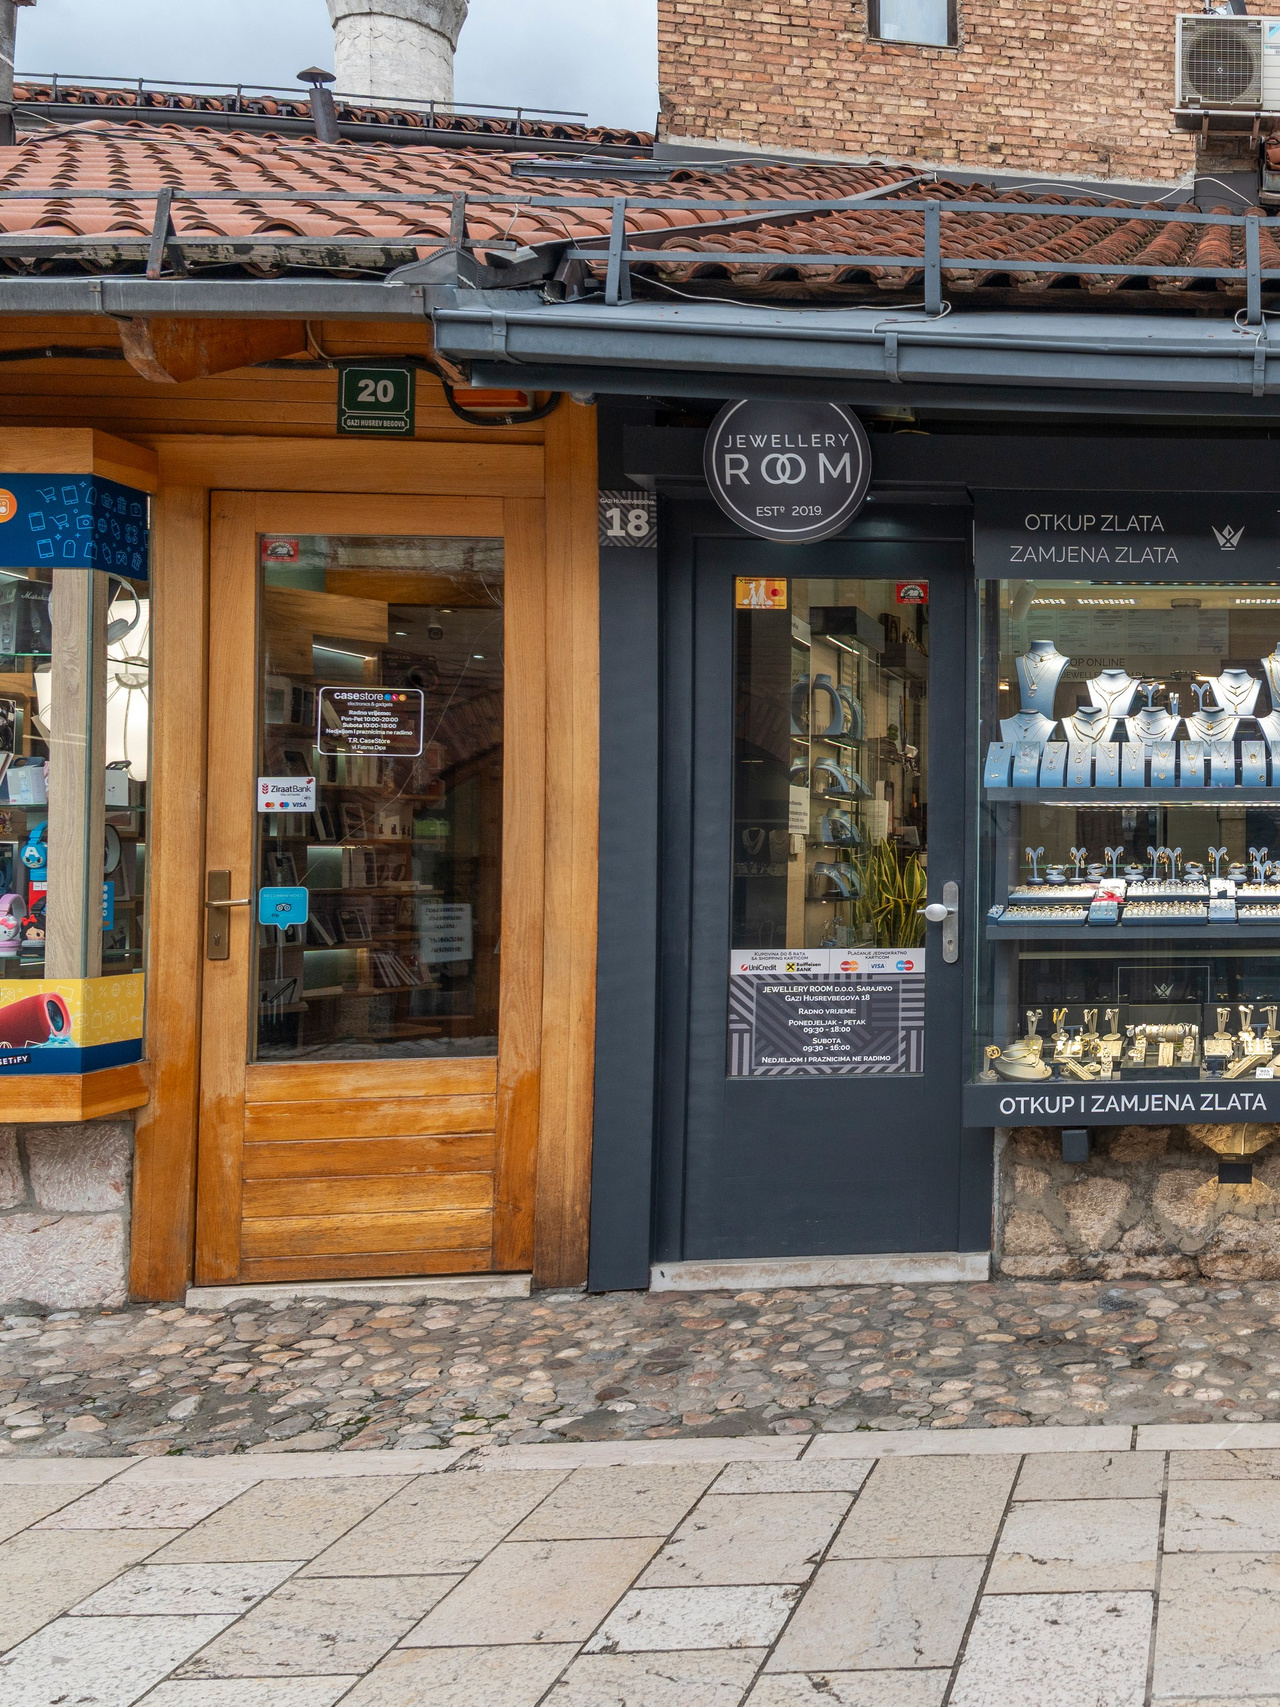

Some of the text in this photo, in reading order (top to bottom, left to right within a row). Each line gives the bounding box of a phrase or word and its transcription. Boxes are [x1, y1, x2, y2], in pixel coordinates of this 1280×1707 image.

[357, 379, 394, 402] 20
[724, 434, 850, 448] JEWELLERY
[724, 452, 851, 485] ROOM
[606, 508, 650, 538] 18
[1024, 514, 1164, 532] OTKUP ZLATA
[1010, 546, 1178, 564] ZAMJENA ZLATA
[21, 591, 50, 600] Marsha
[1086, 658, 1126, 666] ONLINE
[334, 692, 384, 700] casestore
[1000, 1093, 1267, 1114] OTKUP I ZAMJENA ZLATA
